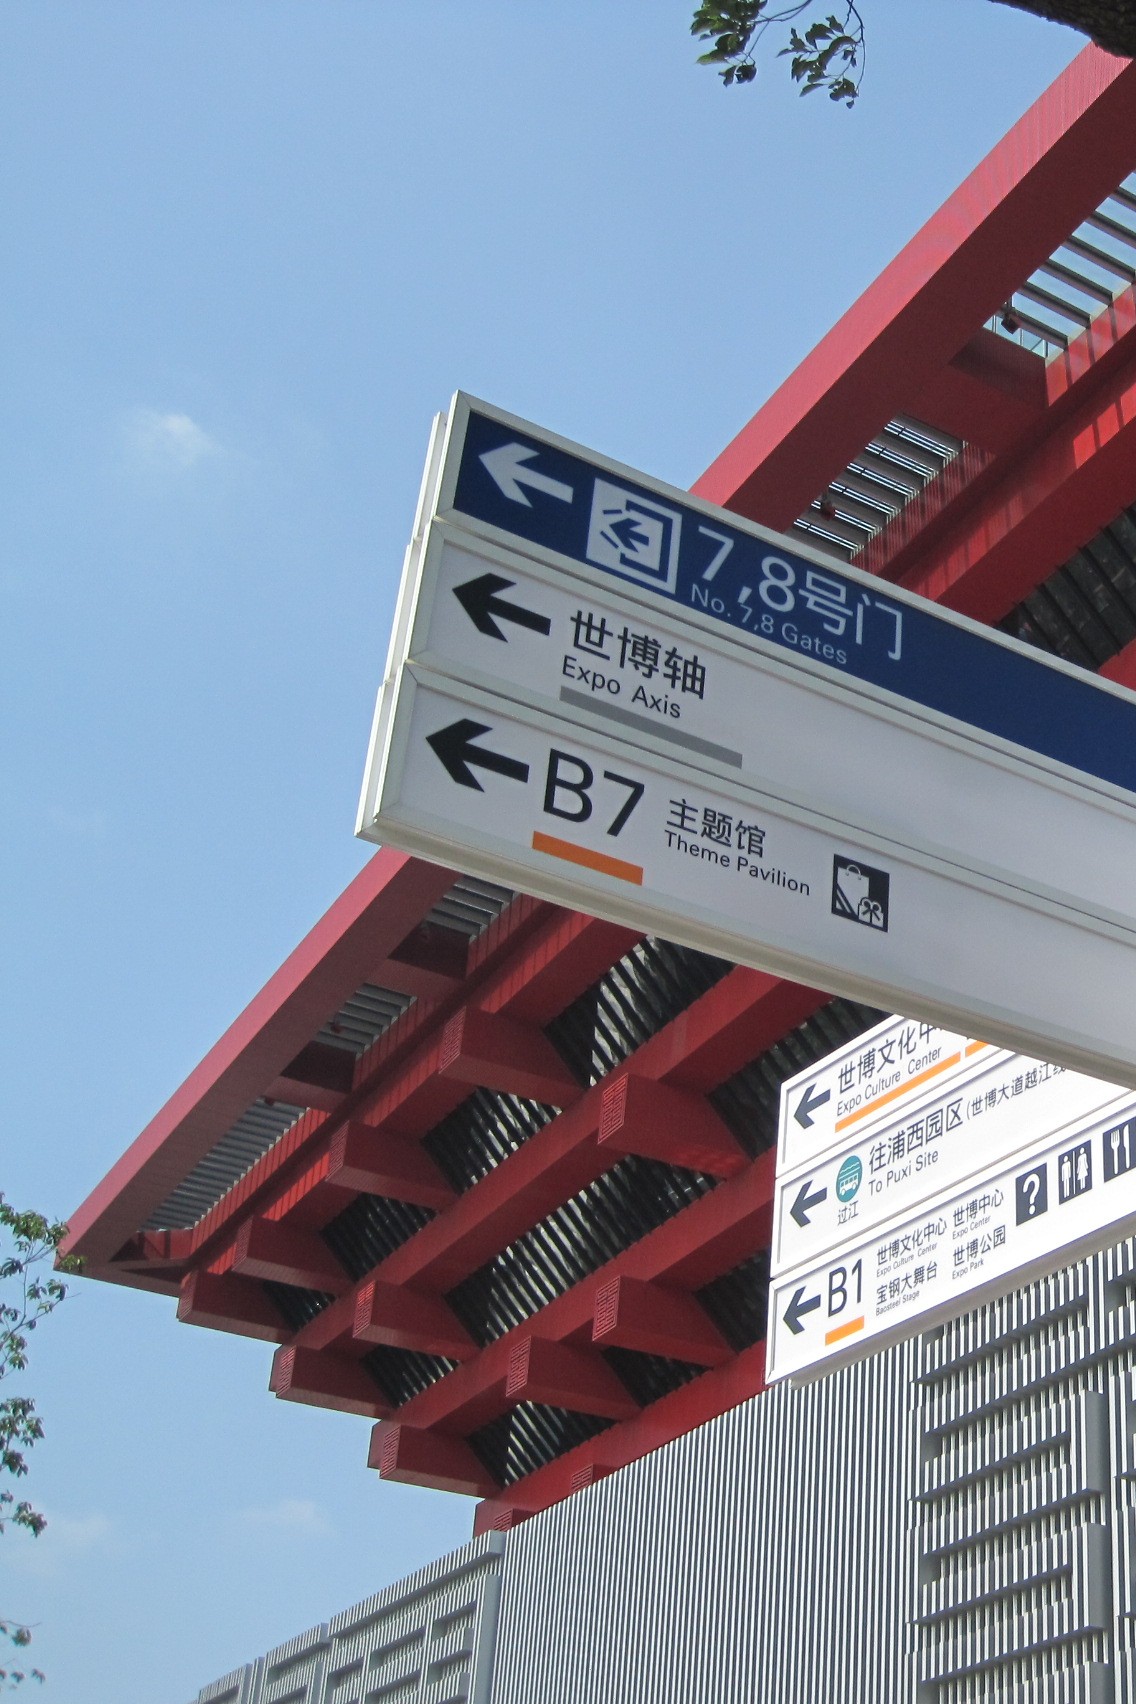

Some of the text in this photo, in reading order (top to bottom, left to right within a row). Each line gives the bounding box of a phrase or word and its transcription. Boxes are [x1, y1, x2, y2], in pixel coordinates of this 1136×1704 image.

[697, 525, 904, 661] 7,8号门
[691, 583, 731, 618] No.
[781, 622, 847, 665] Gates
[569, 609, 707, 700] 世博轴
[561, 654, 682, 719] Expo Axis
[543, 747, 645, 838] B7
[666, 797, 766, 859] 主题馆
[664, 829, 811, 897] Theme Pavilion
[836, 1046, 943, 1117] Expo Culture Center
[837, 1022, 942, 1095] 世博文化中
[868, 1151, 939, 1196] To Puxi Site
[837, 1200, 860, 1227] 过江
[952, 1188, 1005, 1229] 世博中心
[952, 1215, 992, 1241] Expo Center
[876, 1216, 948, 1267] 世博文化中心
[876, 1242, 938, 1278] Expo Culture Center
[951, 1257, 985, 1281] Expo Park
[952, 1224, 1007, 1268] 世博公园
[827, 1258, 863, 1318] B1
[875, 1260, 939, 1306] 宝钢大舞台
[902, 1290, 920, 1304] Stage
